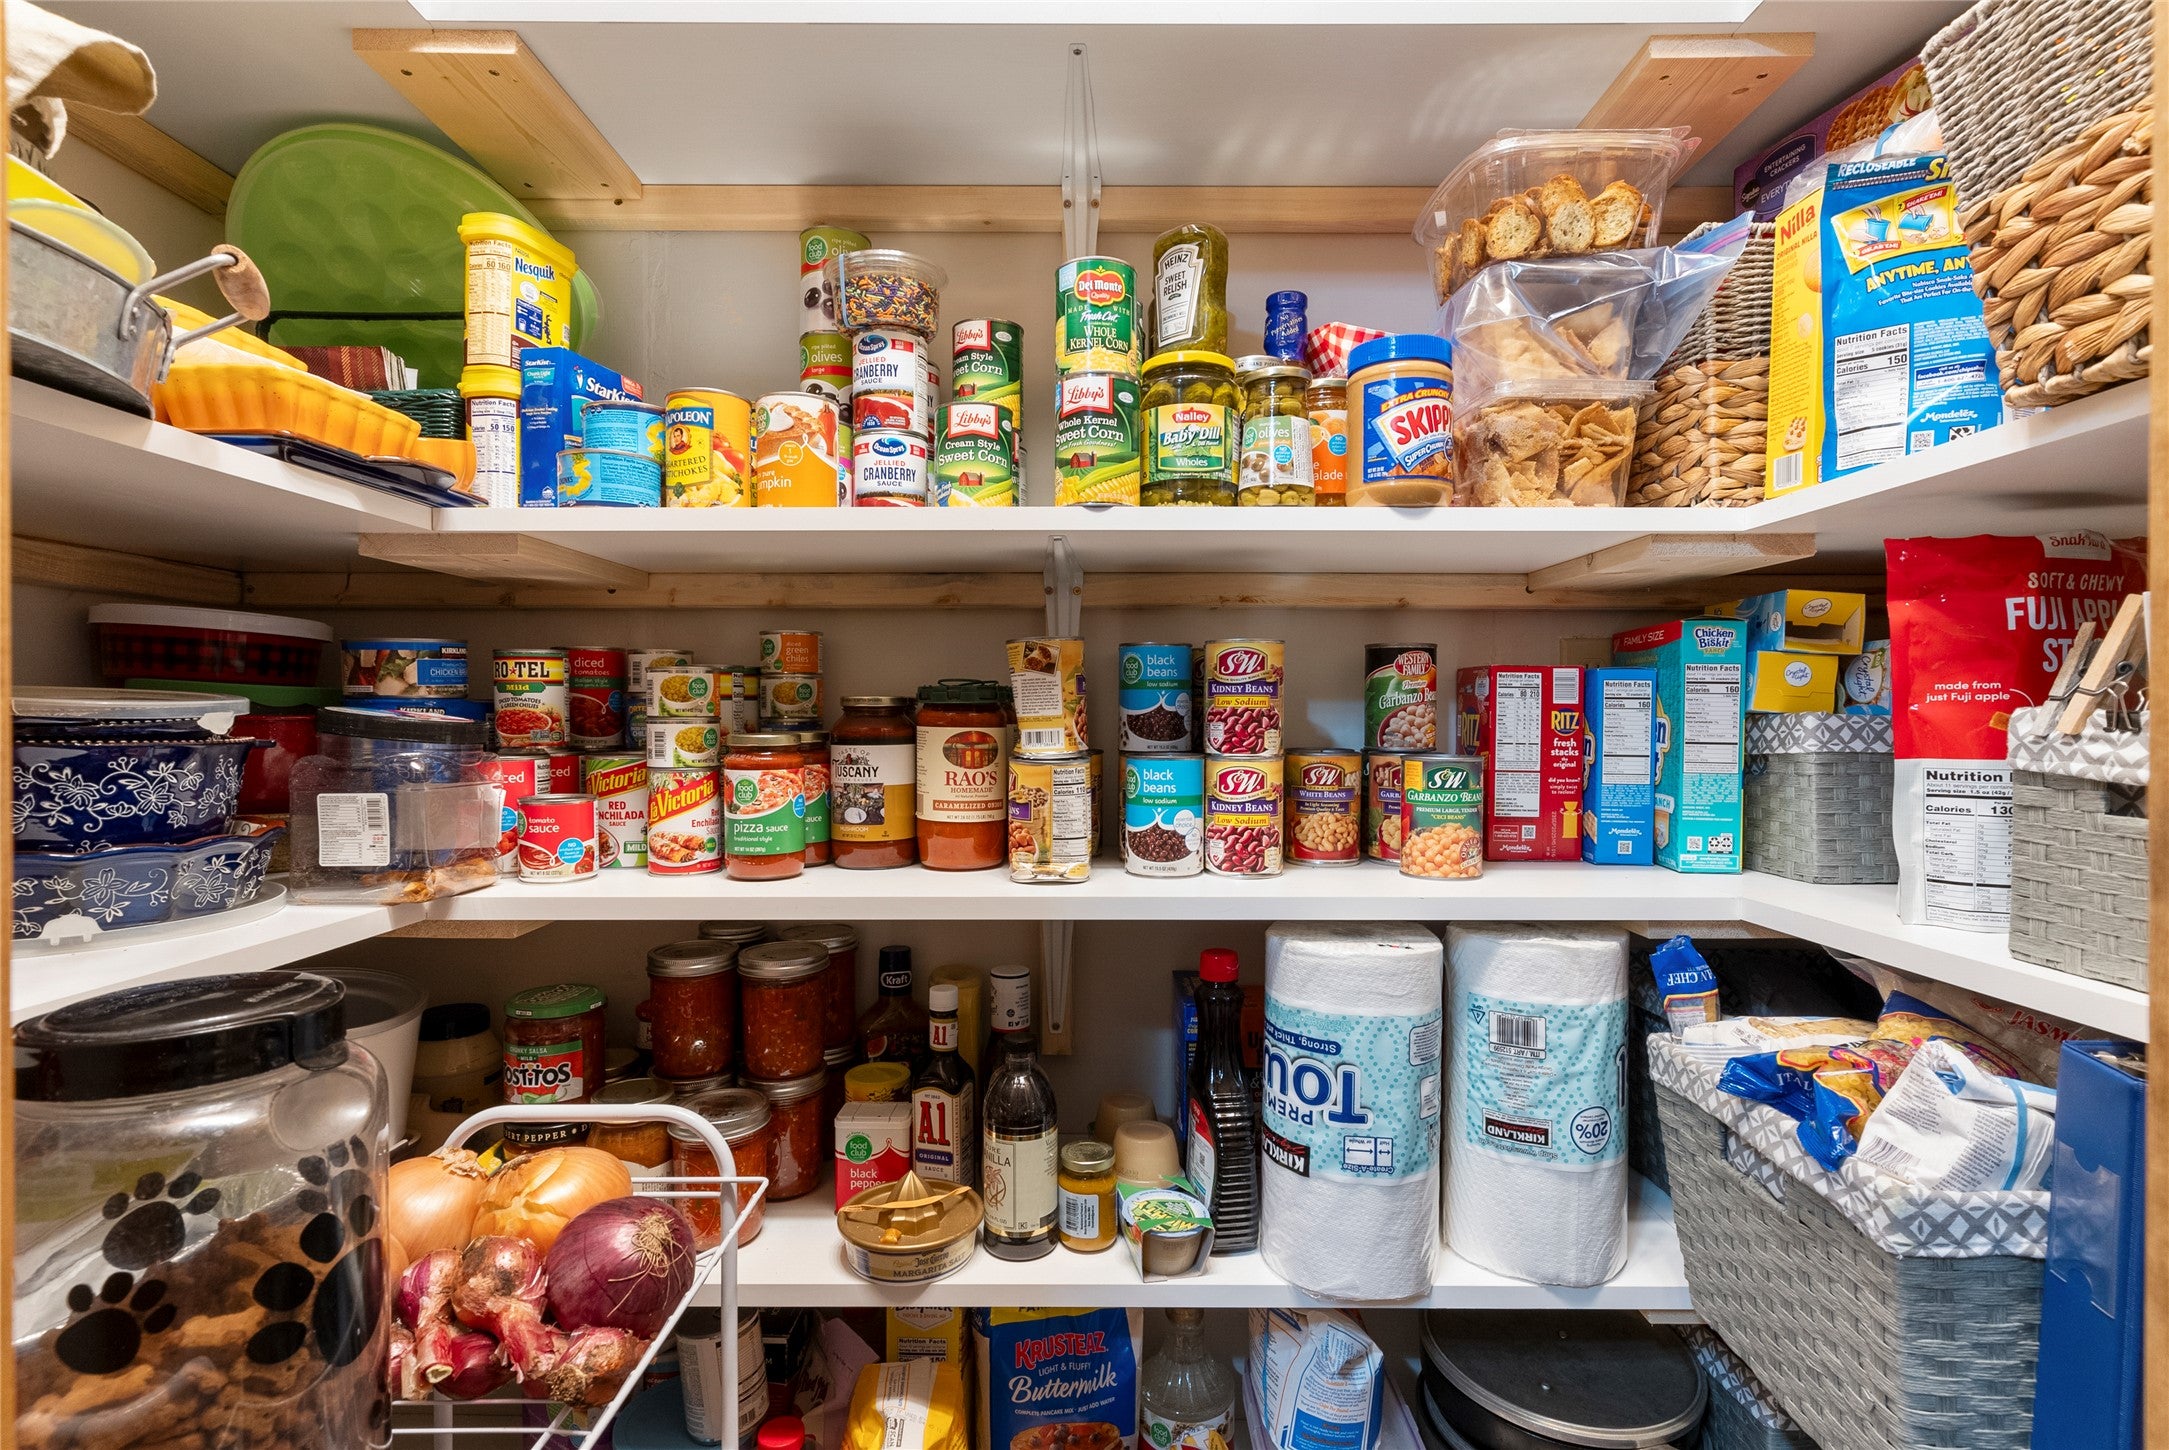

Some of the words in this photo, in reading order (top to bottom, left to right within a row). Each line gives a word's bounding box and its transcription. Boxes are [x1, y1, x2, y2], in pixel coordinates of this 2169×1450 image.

[1764, 143, 1807, 173] ENTERTAINING
[1770, 155, 1800, 178] CRACKERS
[1838, 157, 1916, 178] RECLOSEABLE
[1780, 204, 1816, 246] Nilla
[808, 242, 823, 250] food
[808, 249, 822, 257] club
[1164, 253, 1189, 270] HEINZ
[515, 257, 555, 281] Nesquik
[1164, 270, 1186, 286] SWEET
[1866, 260, 1939, 293] ANYTIME,
[1079, 280, 1093, 292] Del
[1094, 279, 1122, 293] Monte
[1163, 280, 1188, 297] RELISH
[956, 328, 984, 345] Libby's
[1084, 325, 1117, 338] WHOLE
[1837, 332, 1877, 346] Nutrition
[1880, 327, 1907, 338] Facts
[1070, 337, 1104, 350] KERNEL
[1105, 336, 1129, 351] CORN
[811, 351, 843, 363] olives
[970, 353, 994, 362] Style
[970, 362, 1004, 377] Corn
[1836, 363, 1868, 375] Calories
[1887, 353, 1907, 366] 150
[861, 377, 883, 385] SAUCE
[1066, 385, 1104, 405] Libby's
[956, 410, 992, 427] Libby's
[1058, 418, 1082, 432] Whole
[1083, 415, 1118, 427] Kernel
[1175, 411, 1210, 423] Nalley
[1055, 428, 1087, 448] Sweet
[1088, 426, 1125, 443] Corn
[1163, 429, 1195, 446] Baby
[1199, 426, 1221, 440] Dill
[1258, 427, 1290, 439] olives
[945, 439, 975, 451] Cream
[977, 439, 1001, 452] Style
[874, 459, 906, 467] JELLIED
[938, 450, 975, 467] Sweet
[978, 449, 1008, 469] Corn
[1175, 458, 1209, 467] Wholes
[863, 466, 917, 482] CRANBERRY
[2028, 572, 2066, 589] SOFT
[2066, 573, 2075, 590] &
[2080, 575, 2125, 592] CHEWY
[2005, 596, 2068, 631] FUJI
[1623, 634, 1647, 646] FAMILY
[1647, 630, 1665, 642] SIZE
[1694, 628, 1735, 639] Chicken
[1699, 637, 1731, 649] Biskit
[785, 647, 809, 656] green
[574, 656, 605, 668] diced
[785, 654, 809, 663] chiles
[1147, 654, 1175, 665] black
[1220, 650, 1263, 675] S&W
[514, 660, 550, 679] TEL
[574, 668, 610, 676] tomatoes
[1147, 666, 1178, 677] beans
[1402, 663, 1427, 676] FAMILY
[692, 687, 705, 695] club
[1211, 683, 1243, 694] KIDNEY
[1245, 683, 1274, 693] BEANS
[1935, 681, 1969, 690] made
[1972, 681, 2002, 690] from
[511, 696, 541, 704] TOMATOES
[1234, 698, 1267, 706] Sodium
[1378, 692, 1424, 710] Garbanzo
[1926, 691, 1949, 704] just
[1950, 692, 1974, 703] Fuji
[1975, 692, 2011, 703] apple
[1550, 710, 1580, 731] RITZ
[1461, 713, 1480, 747] RITZ
[1553, 738, 1577, 747] fresh
[1550, 747, 1579, 756] stacks
[832, 759, 879, 779] TUSCANY
[1553, 760, 1577, 770] original
[944, 770, 998, 787] RAO'S
[1143, 768, 1174, 781] black
[1220, 769, 1263, 793] S&W
[1304, 767, 1337, 786] S&W
[1428, 769, 1467, 790] S&W
[1926, 770, 2003, 783] Nutrition
[590, 767, 647, 797] Victoria
[1143, 782, 1177, 794] beans
[737, 785, 754, 793] food
[738, 790, 753, 800] club
[1299, 789, 1324, 798] WHITE
[1324, 790, 1346, 798] BEANS
[1407, 789, 1458, 802] GARBANZO
[656, 780, 716, 817] Victoria
[608, 801, 626, 810] RED
[1211, 801, 1243, 812] KIDNEY
[1245, 801, 1274, 812] BEANS
[1416, 806, 1441, 814] PREMIUM
[1925, 804, 1972, 814] Calories
[1234, 816, 1267, 824] Sodium
[528, 824, 561, 834] sauce
[734, 820, 764, 835] pizza
[765, 823, 789, 833] sauce
[885, 974, 909, 985] Kraft
[1666, 971, 1699, 987] CHEF
[932, 1025, 949, 1046] A1
[1298, 1035, 1338, 1053] Strong,
[918, 1100, 951, 1146] A1
[524, 1129, 567, 1143] PEPPER
[1487, 1126, 1546, 1145] KIRKLAND
[1575, 1121, 1609, 1140] 20%
[850, 1141, 868, 1151] food
[850, 1149, 868, 1158] club
[918, 1153, 950, 1162] ORIGINAL
[850, 1168, 878, 1180] black
[924, 1165, 944, 1173] SAUCE
[1342, 1163, 1395, 1174] Create-A-Size
[893, 1262, 947, 1278] MARGARITA
[949, 1254, 966, 1270] SALT
[1015, 1331, 1107, 1370] KRUSTEAZ
[1038, 1364, 1059, 1377] LIGHT
[1060, 1362, 1067, 1372] &
[1069, 1361, 1092, 1372] FLUFFY
[1008, 1361, 1118, 1404] Buttermilk
